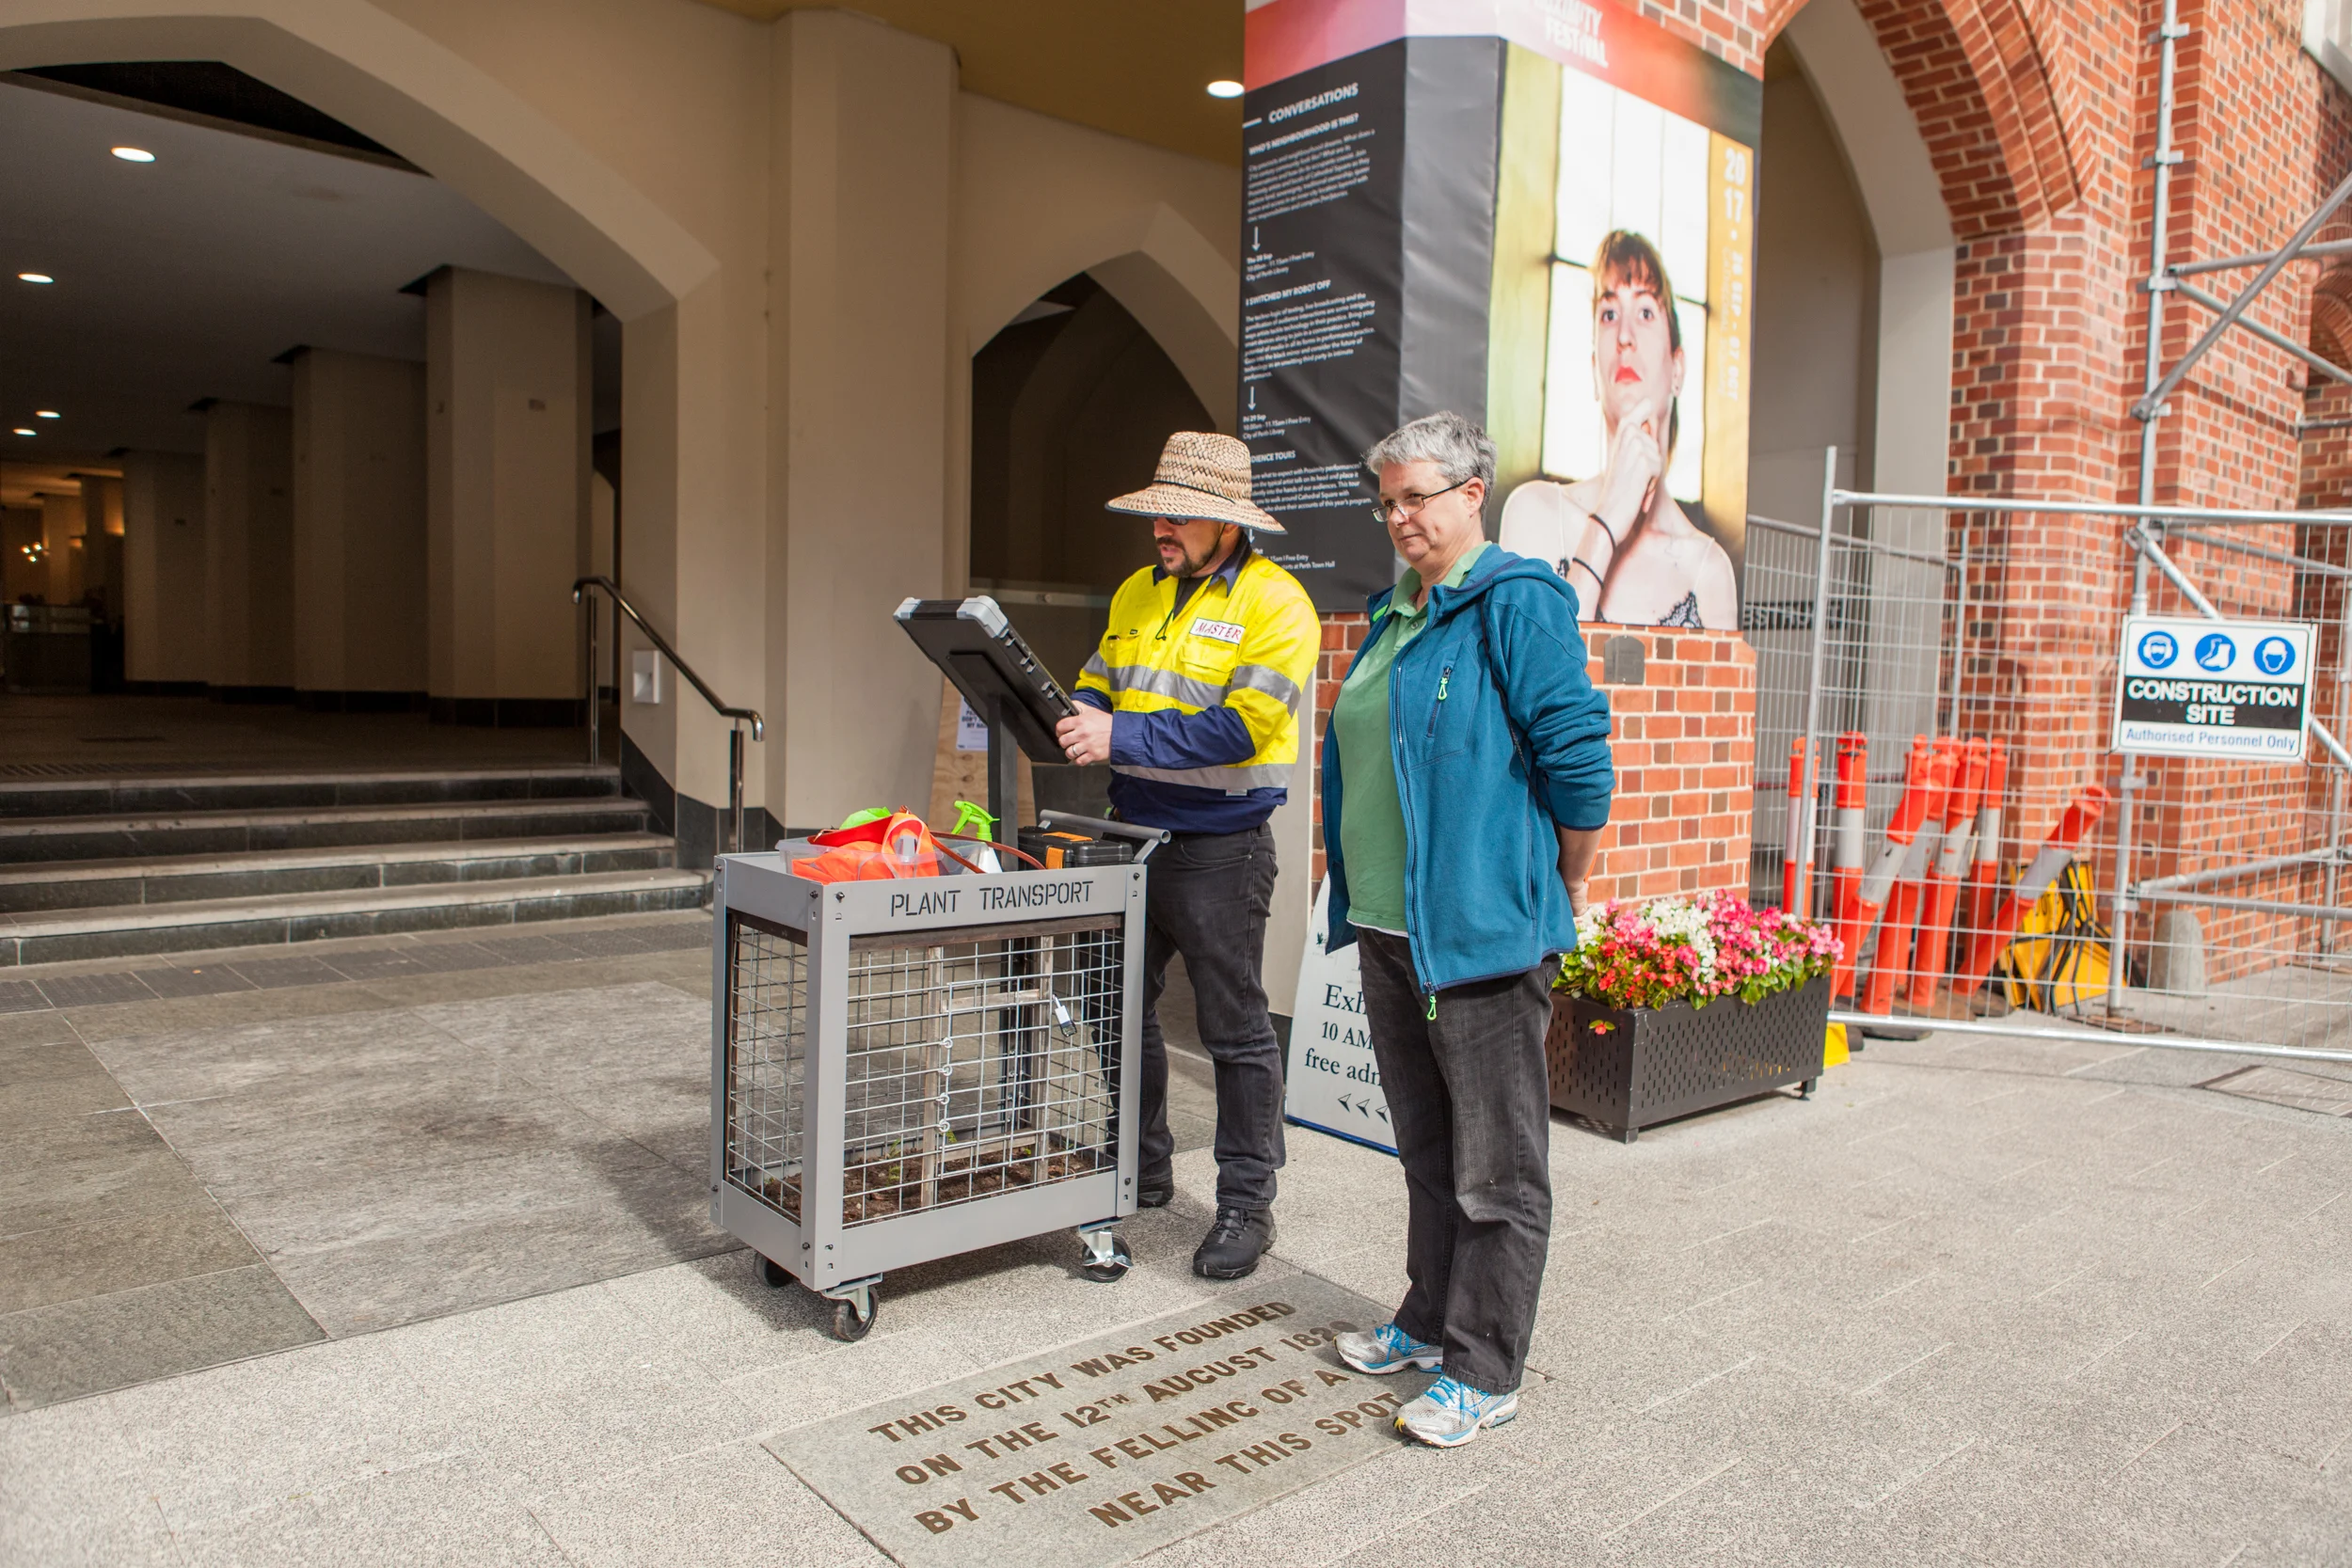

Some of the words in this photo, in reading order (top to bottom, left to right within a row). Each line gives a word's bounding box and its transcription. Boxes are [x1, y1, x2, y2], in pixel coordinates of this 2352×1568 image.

[1545, 14, 1609, 69] FESTIVAL
[1268, 82, 1359, 124] CONVERSATIONS
[1271, 121, 1330, 149] NEIGHBOURHOOD
[1338, 112, 1359, 127] THIS?
[1724, 147, 1746, 186] 20
[1724, 188, 1745, 223] 17
[1250, 290, 1281, 306] SWITCHED
[1282, 288, 1293, 299] MY
[1293, 282, 1316, 296] ROBOT
[1316, 279, 1331, 291] OFF
[1257, 414, 1266, 422] Sep
[1299, 415, 1311, 425] Entry
[1242, 432, 1252, 441] City
[1251, 453, 1274, 464] DIENCE
[1275, 450, 1296, 461] TOURS
[1196, 623, 1242, 641] MASTER
[2127, 679, 2298, 707] CONSTRUCTION
[2185, 704, 2235, 725] SITE
[2126, 728, 2194, 744] Authorised
[2199, 732, 2262, 747] Personnel
[2267, 735, 2295, 751] Only
[891, 889, 961, 917] PLANT
[979, 881, 1094, 911] TRANSPORT
[1322, 1021, 1338, 1041] 10
[1304, 1047, 1340, 1075] free
[866, 1404, 967, 1443] THIS
[975, 1370, 1065, 1409] CITY
[1071, 1345, 1155, 1378] WAS
[1152, 1300, 1297, 1353] FOUNDED
[895, 1453, 963, 1485] ON
[964, 1421, 1060, 1459] THE
[1141, 1346, 1279, 1403] AUGUST
[914, 1498, 980, 1536] BY
[989, 1462, 1089, 1504] THE
[1089, 1400, 1260, 1469] FELLING
[1261, 1379, 1309, 1404] OF
[1314, 1369, 1351, 1387] A
[1087, 1472, 1217, 1529] NEAR
[1214, 1433, 1312, 1475] THIS
[1314, 1392, 1405, 1436] SPOT
